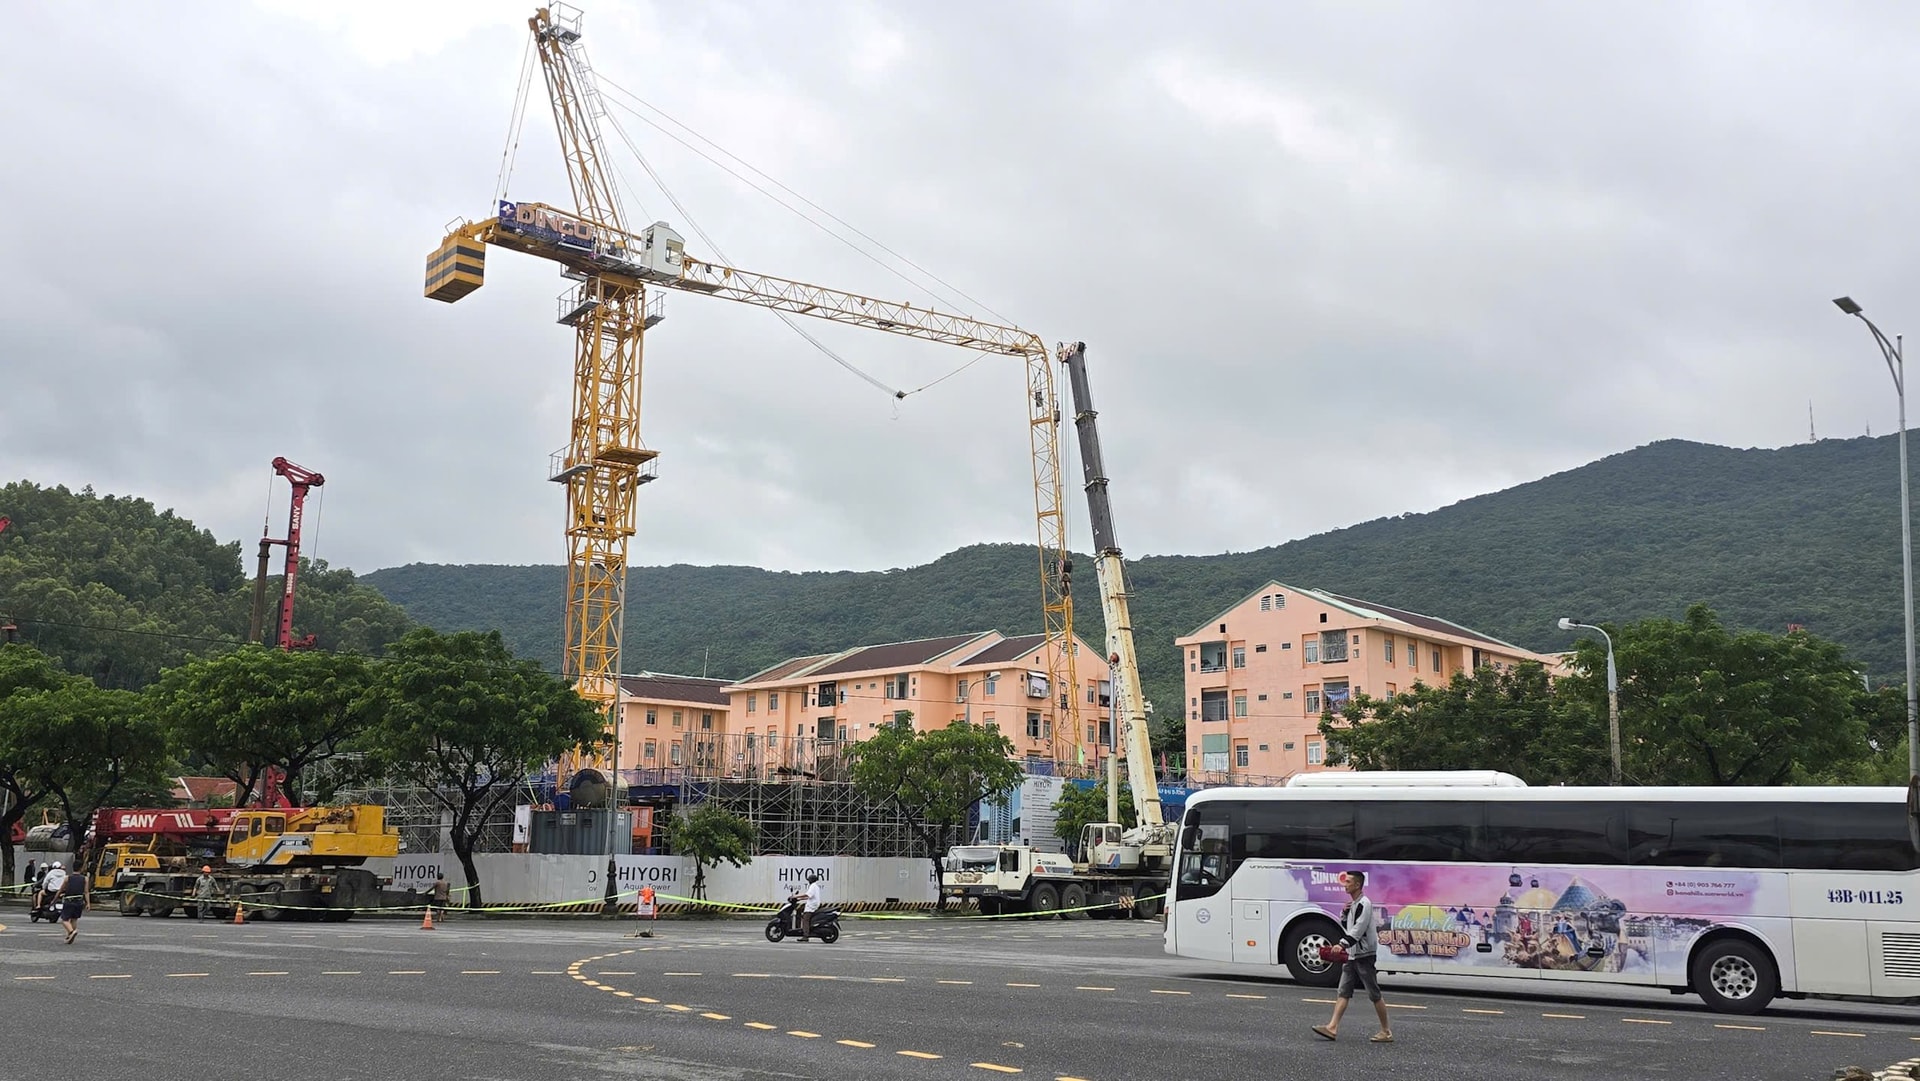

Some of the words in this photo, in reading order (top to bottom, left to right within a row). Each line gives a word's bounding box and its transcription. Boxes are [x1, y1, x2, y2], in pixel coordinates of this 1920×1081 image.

[292, 505, 301, 530] SANY
[120, 814, 158, 828] SANY
[123, 858, 148, 867] SANY
[394, 865, 440, 879] HIYORI
[619, 866, 677, 882] HIYORI
[778, 867, 830, 882] HIYORI
[623, 883, 644, 891] Aqua
[648, 883, 671, 891] Tower
[1827, 889, 1903, 905] 43B-011.25
[1379, 930, 1410, 945] SUN
[1409, 930, 1471, 948] WORLD
